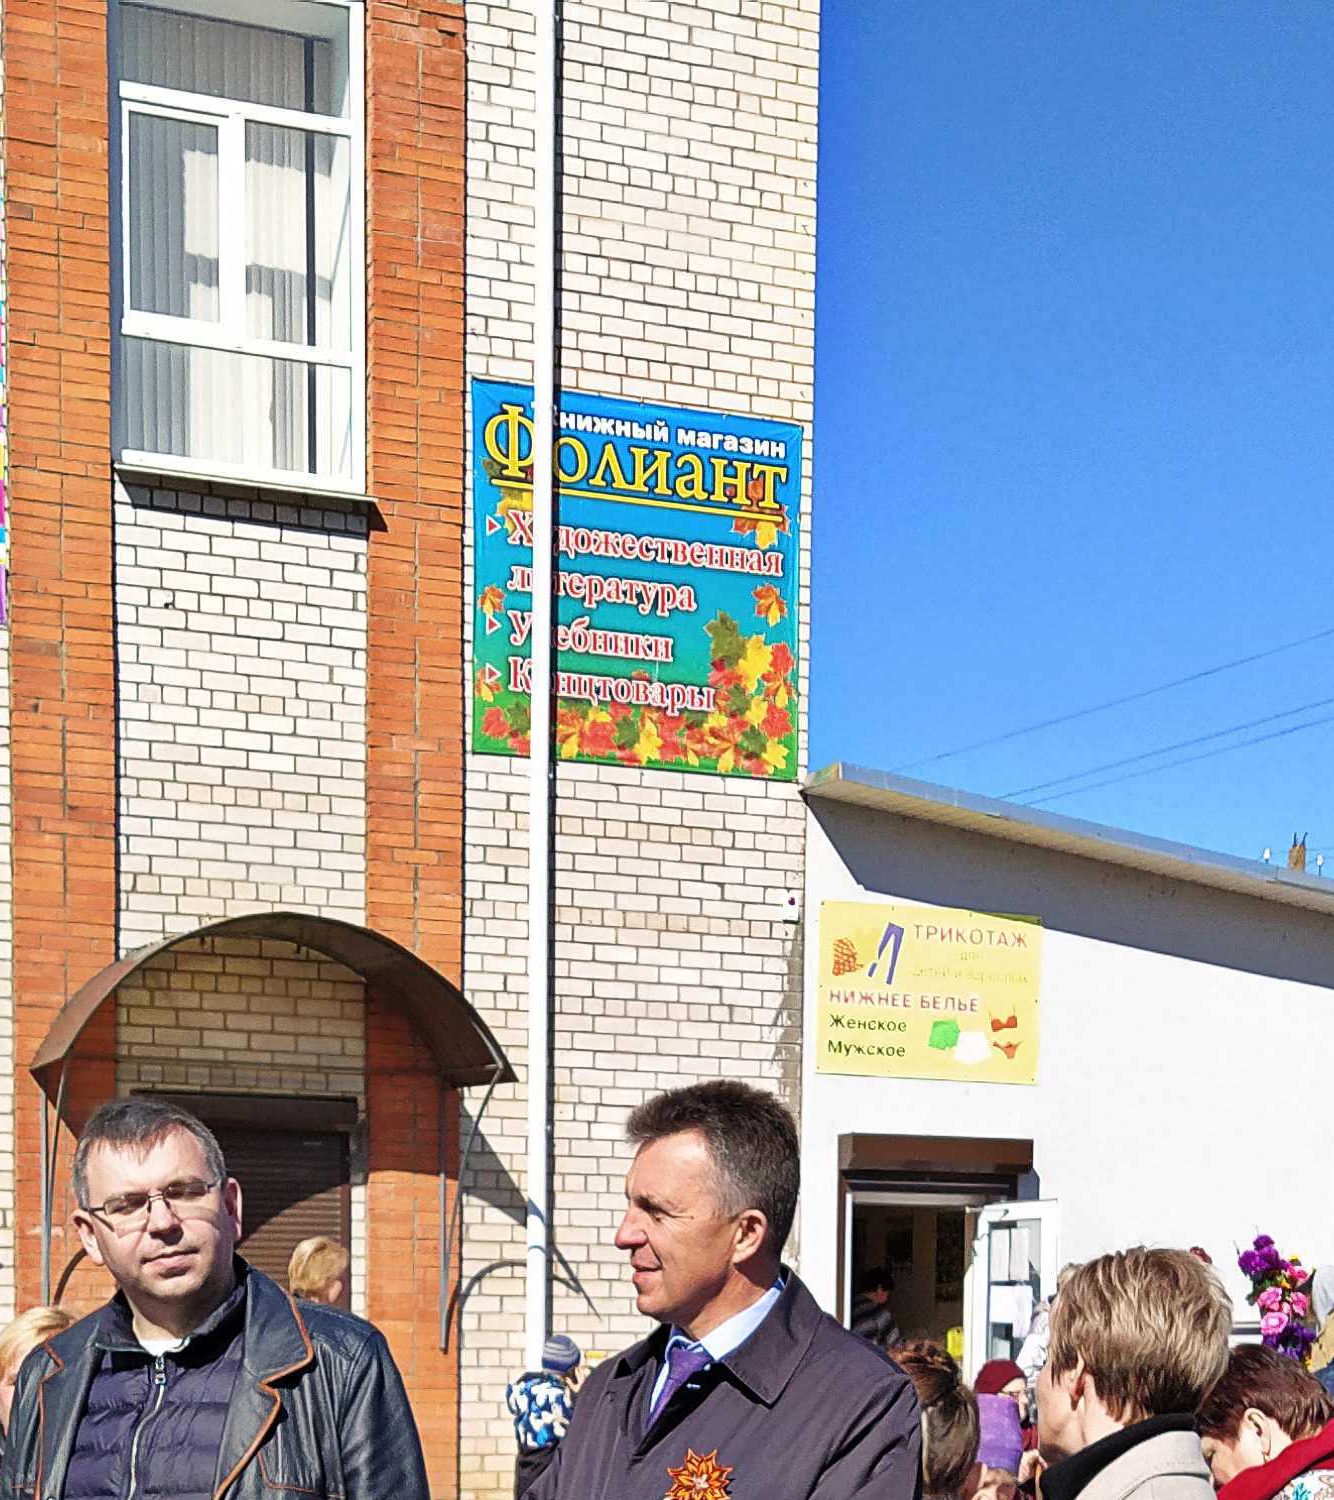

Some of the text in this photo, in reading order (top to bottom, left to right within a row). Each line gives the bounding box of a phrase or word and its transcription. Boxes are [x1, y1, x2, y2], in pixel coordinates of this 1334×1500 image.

[484, 403, 788, 509] Фолиант
[551, 404, 786, 459] нижный магазин
[507, 509, 784, 577] Хдожественная
[507, 565, 695, 616] лтература
[507, 610, 673, 662] уебники
[508, 656, 716, 716] Кнцтовары
[913, 924, 1028, 949] ТРИКОТАЖ
[829, 989, 978, 1012] НИЖНЕЕ БЕЛЬЕ
[829, 1013, 907, 1032] Женское
[827, 1039, 906, 1058] Мужское
